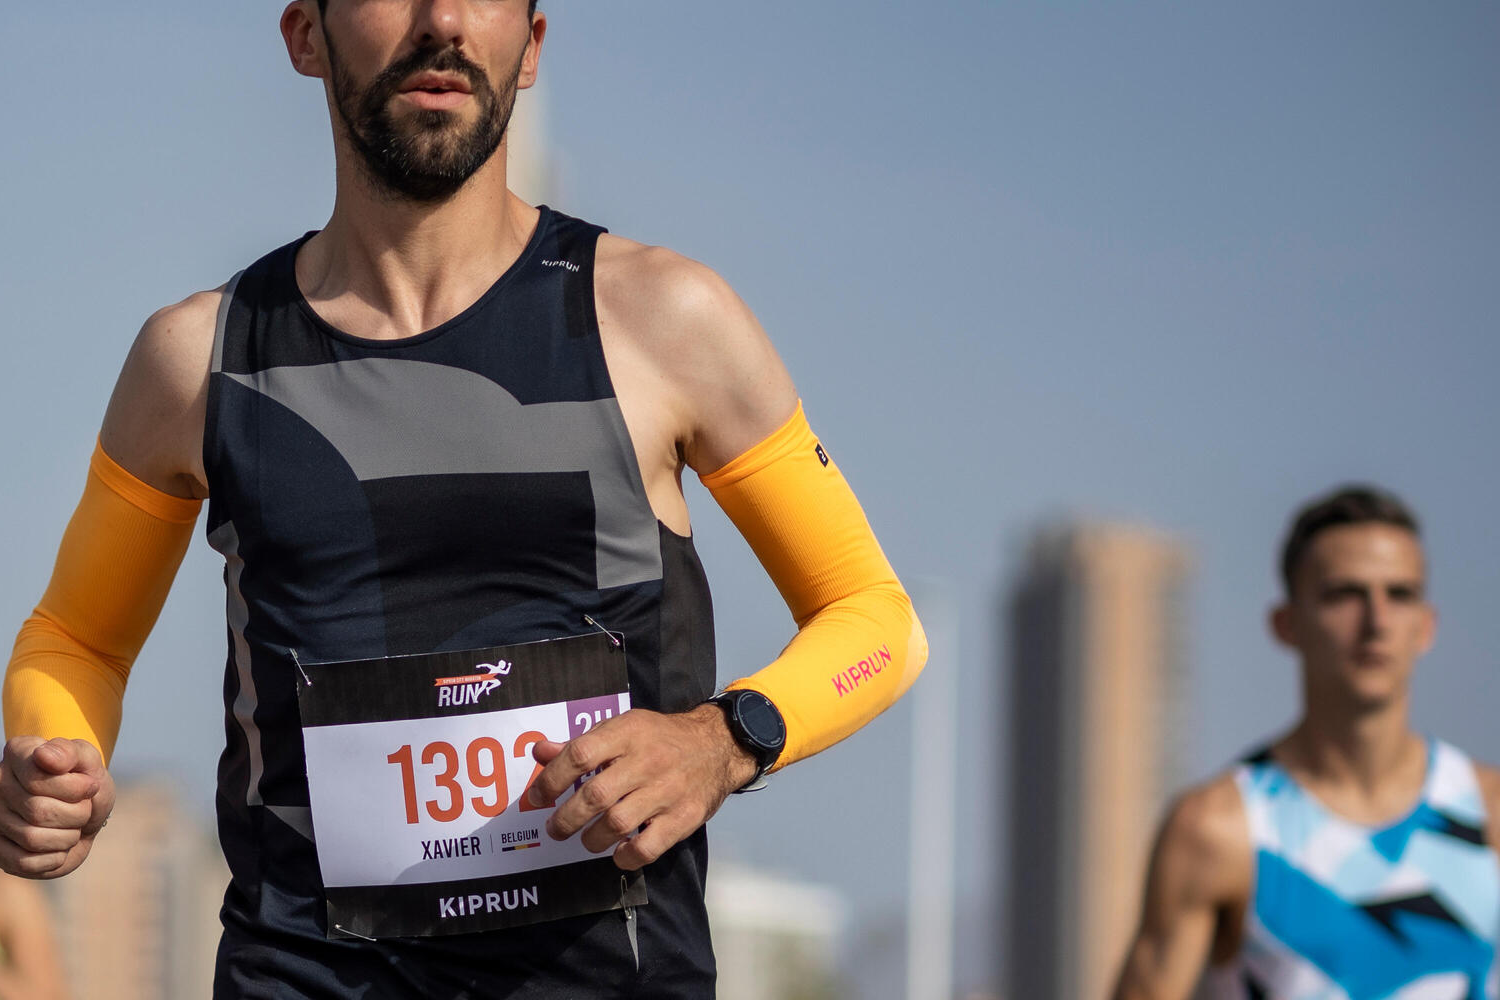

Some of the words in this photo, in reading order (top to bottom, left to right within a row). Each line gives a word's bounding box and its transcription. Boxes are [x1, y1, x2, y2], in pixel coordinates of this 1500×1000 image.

[541, 259, 580, 272] KIPRUN
[831, 644, 892, 698] KIPRUN
[438, 683, 480, 707] RUN
[387, 731, 556, 824] 1392
[421, 836, 482, 860] XAVIER
[501, 828, 539, 844] BELGIUM
[439, 886, 539, 918] KIPRUN
